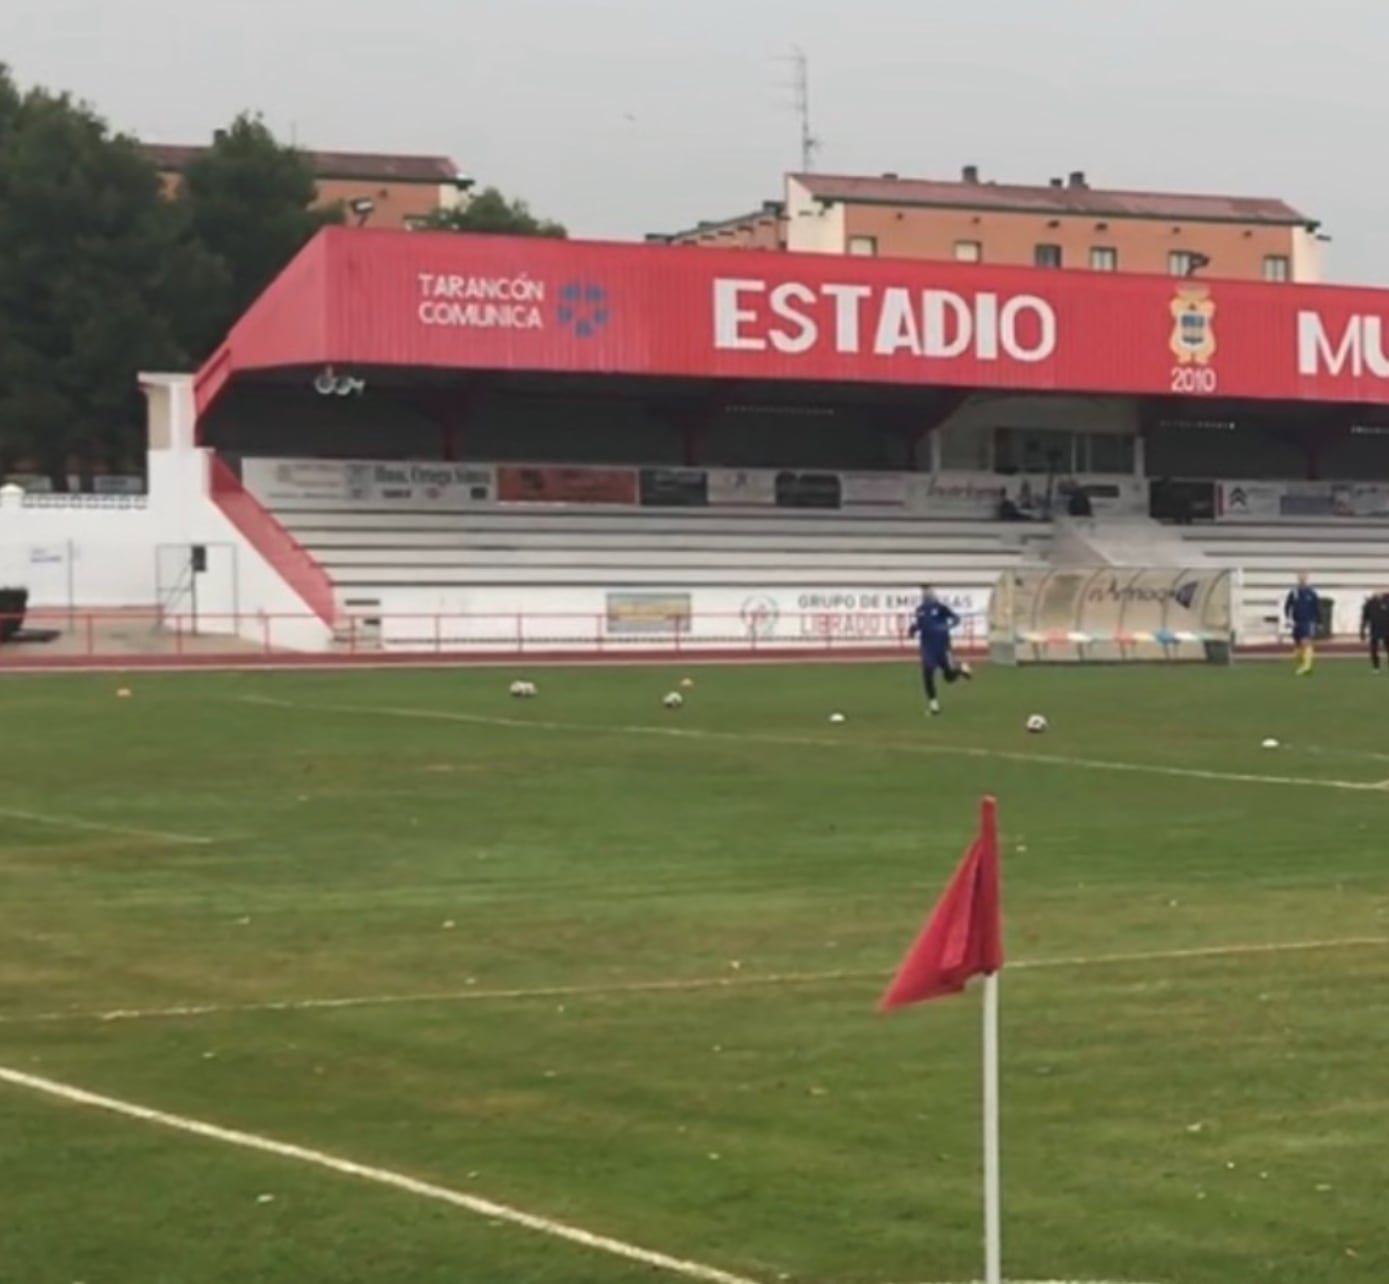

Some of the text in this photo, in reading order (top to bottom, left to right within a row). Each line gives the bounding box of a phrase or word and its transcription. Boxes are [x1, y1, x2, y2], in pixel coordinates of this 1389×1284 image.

[418, 272, 544, 301] TARANCÓN
[418, 302, 543, 330] COMUNICA
[713, 278, 1056, 362] ESTADIO
[1171, 366, 1217, 393] 2010
[798, 594, 856, 609] GRUPO
[860, 594, 880, 609] DE
